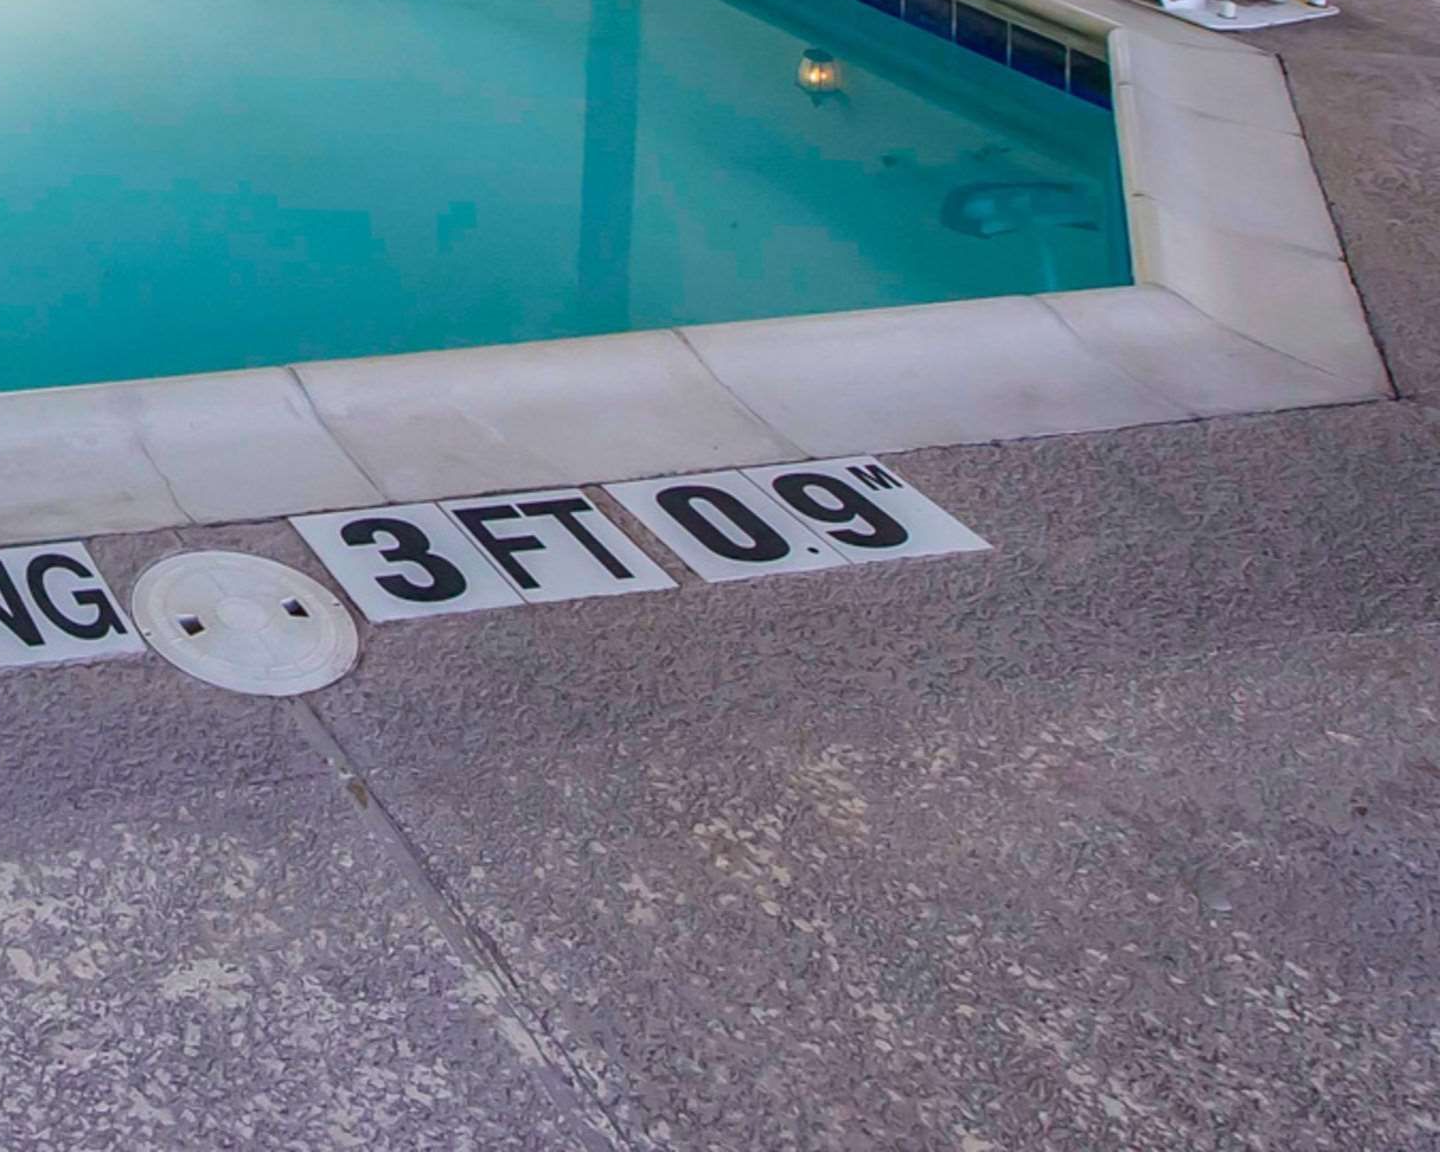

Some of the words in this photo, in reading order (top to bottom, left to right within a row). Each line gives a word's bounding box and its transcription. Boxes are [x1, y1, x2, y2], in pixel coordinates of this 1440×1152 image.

[339, 517, 468, 603] 3
[453, 497, 635, 590] FT
[655, 471, 909, 564] 0.9
